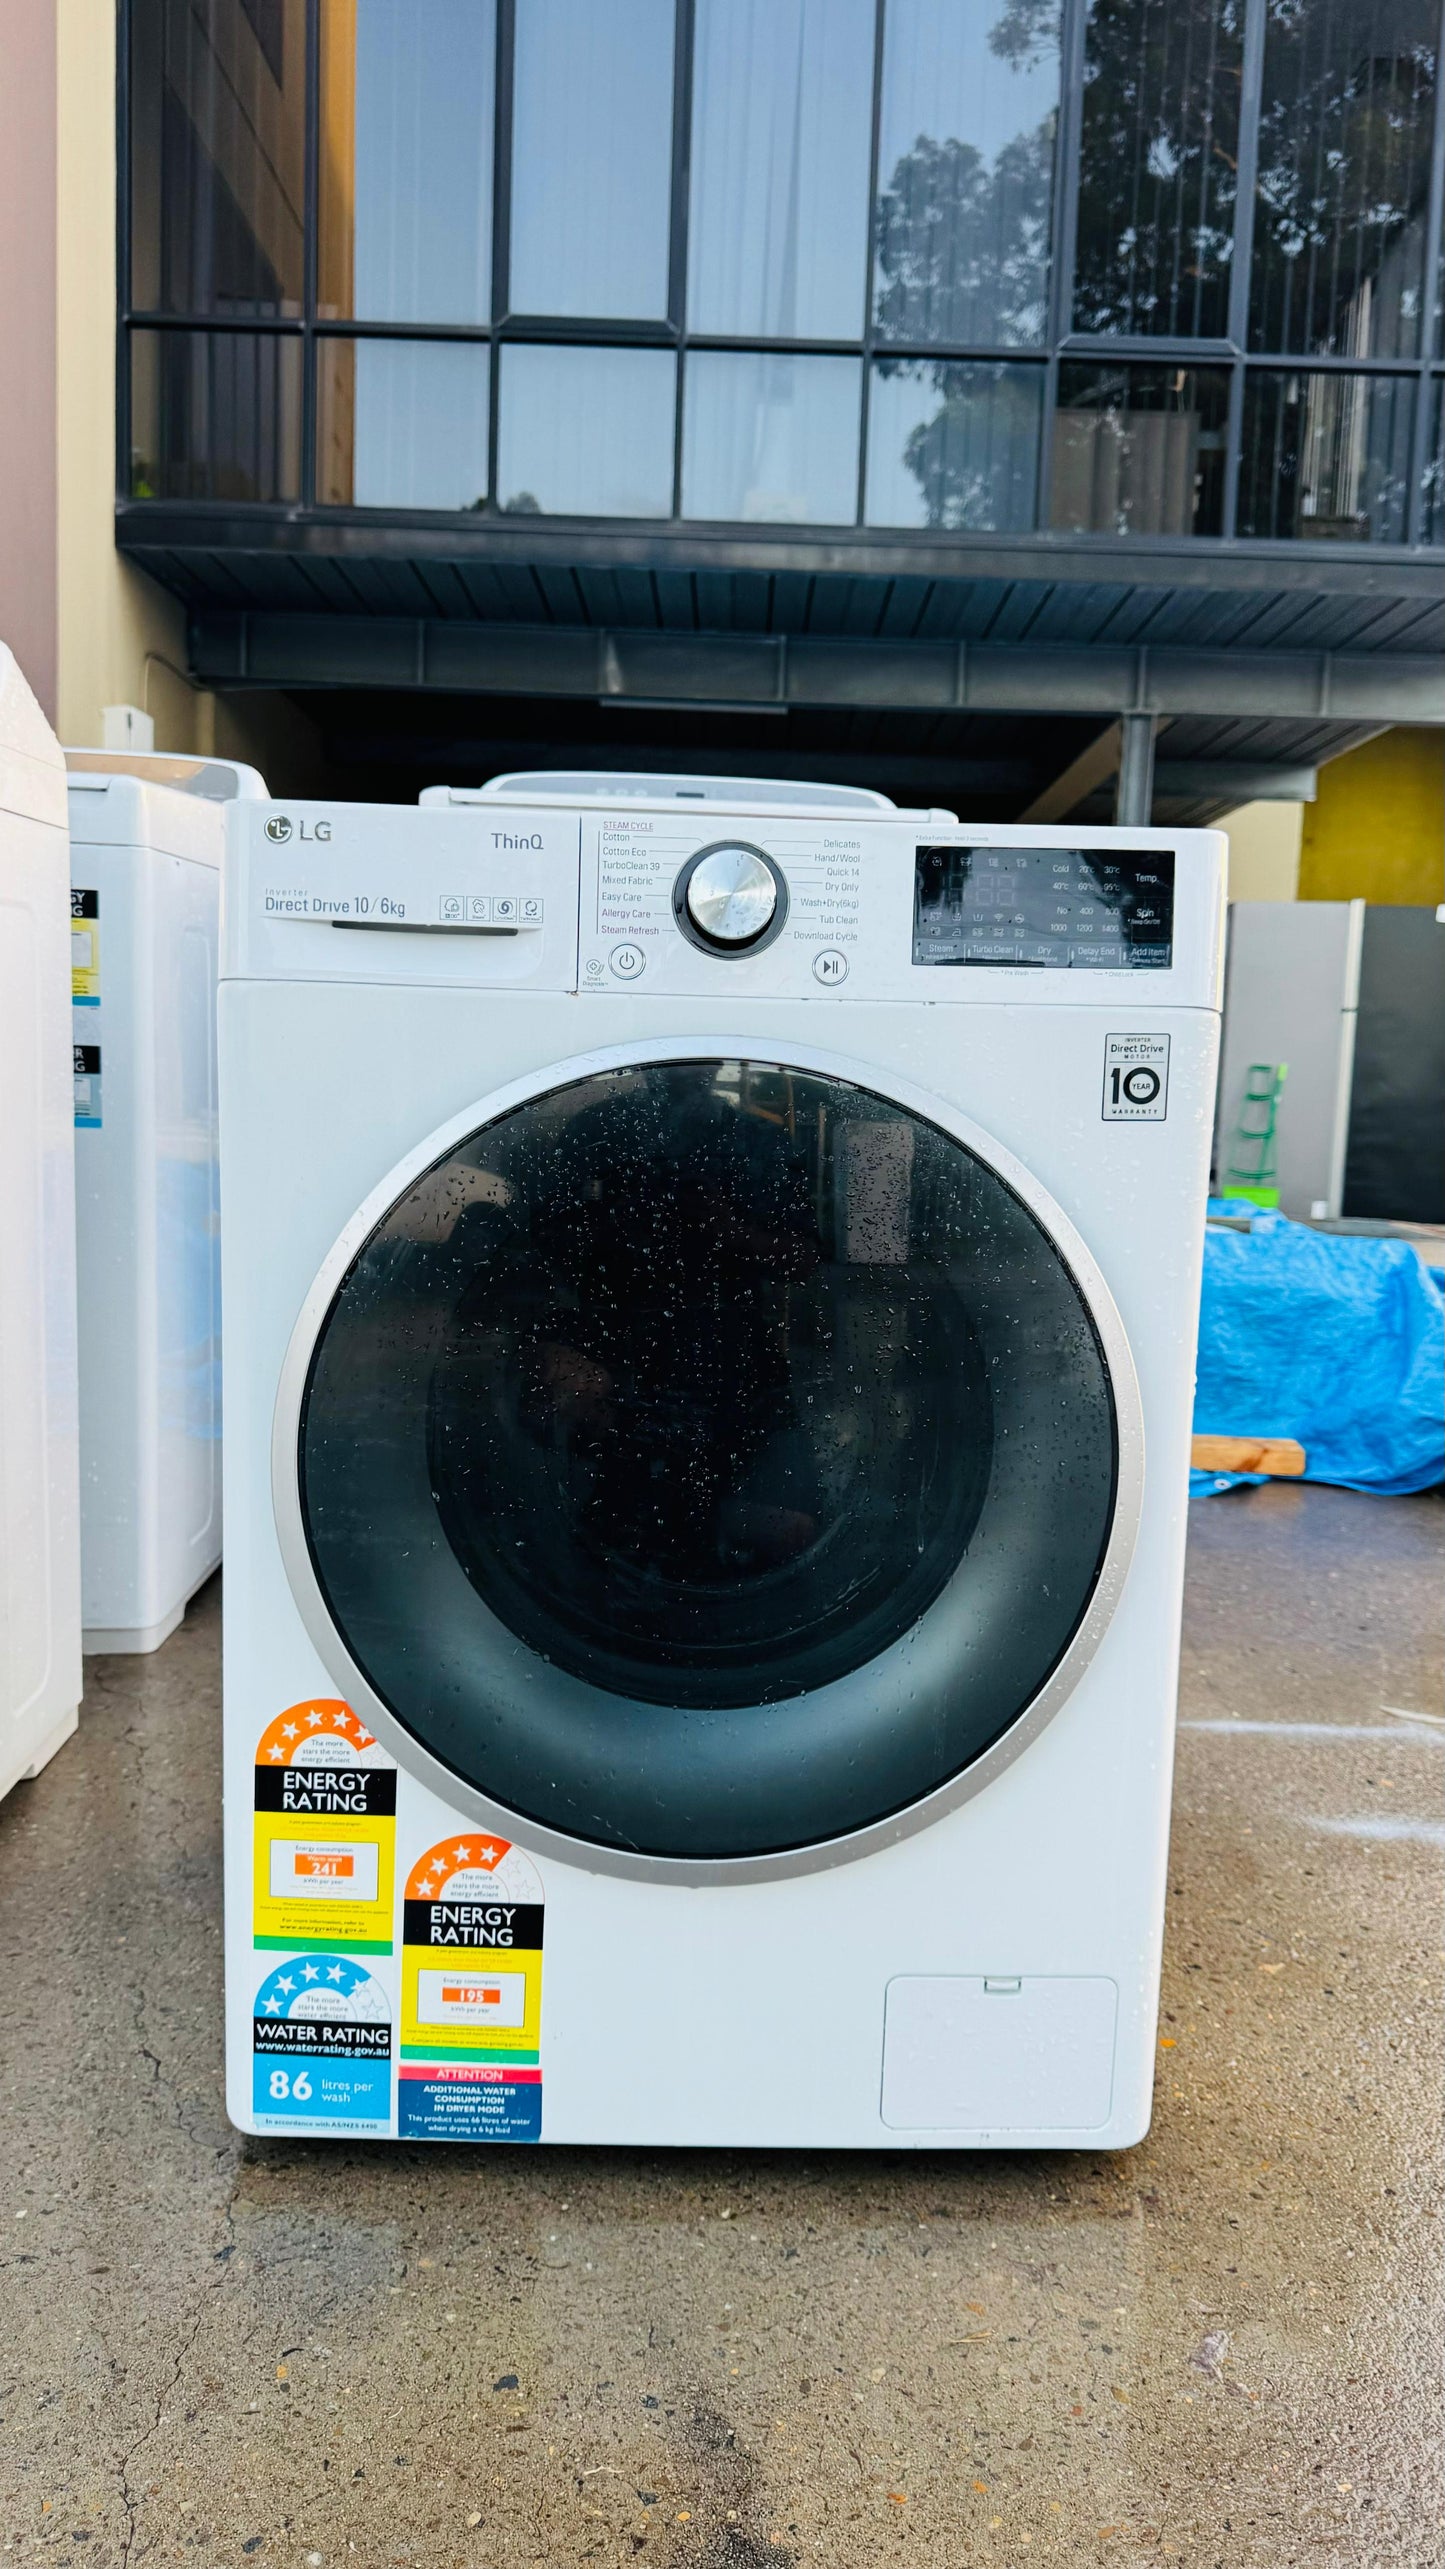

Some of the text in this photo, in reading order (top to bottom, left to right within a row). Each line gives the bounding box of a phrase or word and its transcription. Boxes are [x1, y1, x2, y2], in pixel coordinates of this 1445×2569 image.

[300, 820, 332, 842] LG
[491, 833, 544, 850] ThinQ
[604, 833, 630, 841] Cotton
[824, 840, 860, 848] Delicates
[604, 848, 630, 856] Cotton
[815, 854, 860, 862] Hand/Wool
[604, 861, 660, 870] TurboClean 39
[1052, 864, 1069, 872] Cold
[827, 868, 848, 876] Quick
[602, 876, 653, 886] Mixed Fabric
[1136, 874, 1159, 882] Temp.
[826, 882, 859, 892] Dry Only
[266, 888, 308, 896] Inverter
[602, 893, 622, 902] Easy
[266, 898, 308, 912] Direct
[313, 898, 350, 912] Drive
[602, 909, 650, 918] Allergy Care
[1136, 908, 1154, 918] Spin
[820, 916, 858, 924] Tub Clean
[602, 926, 660, 934] Steam Refresh
[794, 932, 858, 941] Download Cycle
[930, 944, 954, 952] Steam
[1038, 946, 1052, 956] Dry
[1078, 947, 1115, 956] Delay End
[1111, 1044, 1164, 1052] Direct Drive
[1111, 1067, 1160, 1104] 10
[284, 1771, 370, 1791] ENERGY
[282, 1792, 367, 1812] RATING
[312, 1862, 336, 1876] 241
[430, 1906, 516, 1926] ENERGY
[430, 1926, 514, 1946] RATING
[460, 1990, 484, 2002] 195
[257, 2024, 317, 2040] WATER
[323, 2027, 388, 2044] RATING
[256, 2042, 389, 2057] www.waterrating.gov.au
[437, 2069, 503, 2080] ATTENTION
[270, 2070, 312, 2101] 86
[322, 2078, 374, 2092] litres per
[424, 2085, 516, 2096] ADDITIONAL WATER
[322, 2092, 350, 2103] wash
[434, 2095, 504, 2104] CONSUMPTION
[434, 2104, 444, 2112] IN
[424, 2115, 452, 2124] product
[449, 2126, 471, 2134] drying
[486, 2126, 494, 2134] kg
